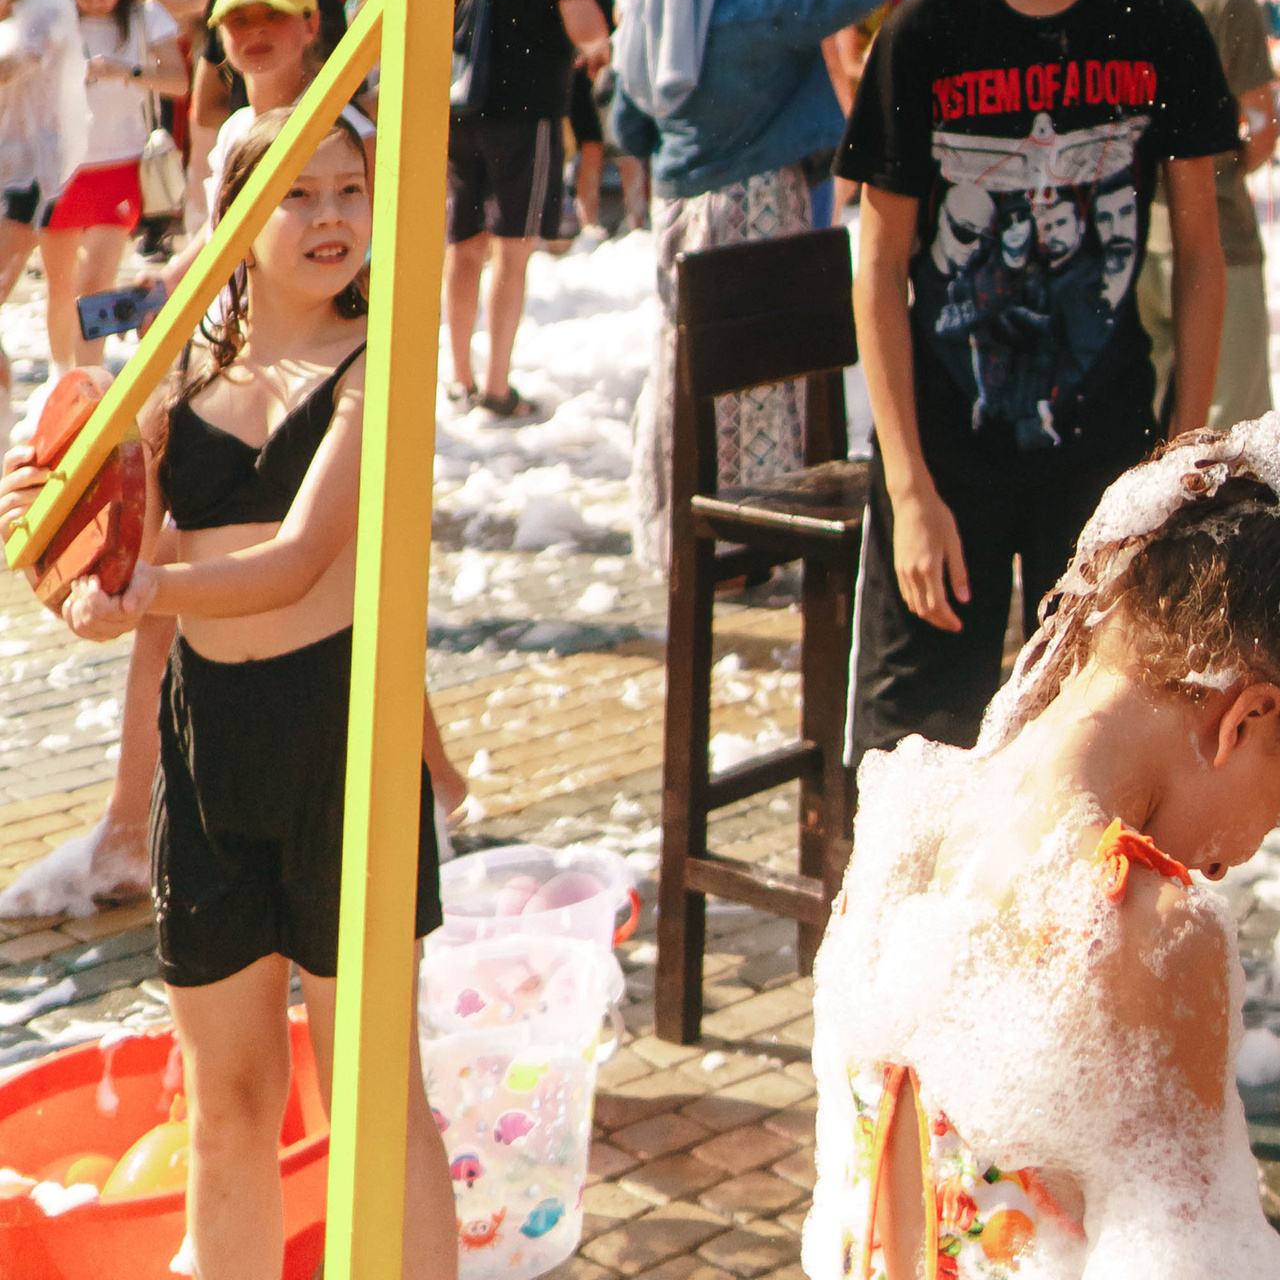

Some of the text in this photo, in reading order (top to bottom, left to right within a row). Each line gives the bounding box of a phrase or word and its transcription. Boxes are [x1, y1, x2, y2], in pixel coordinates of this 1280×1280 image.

[1026, 63, 1062, 112] OF
[1062, 60, 1081, 107] A
[1086, 59, 1158, 106] DOWN
